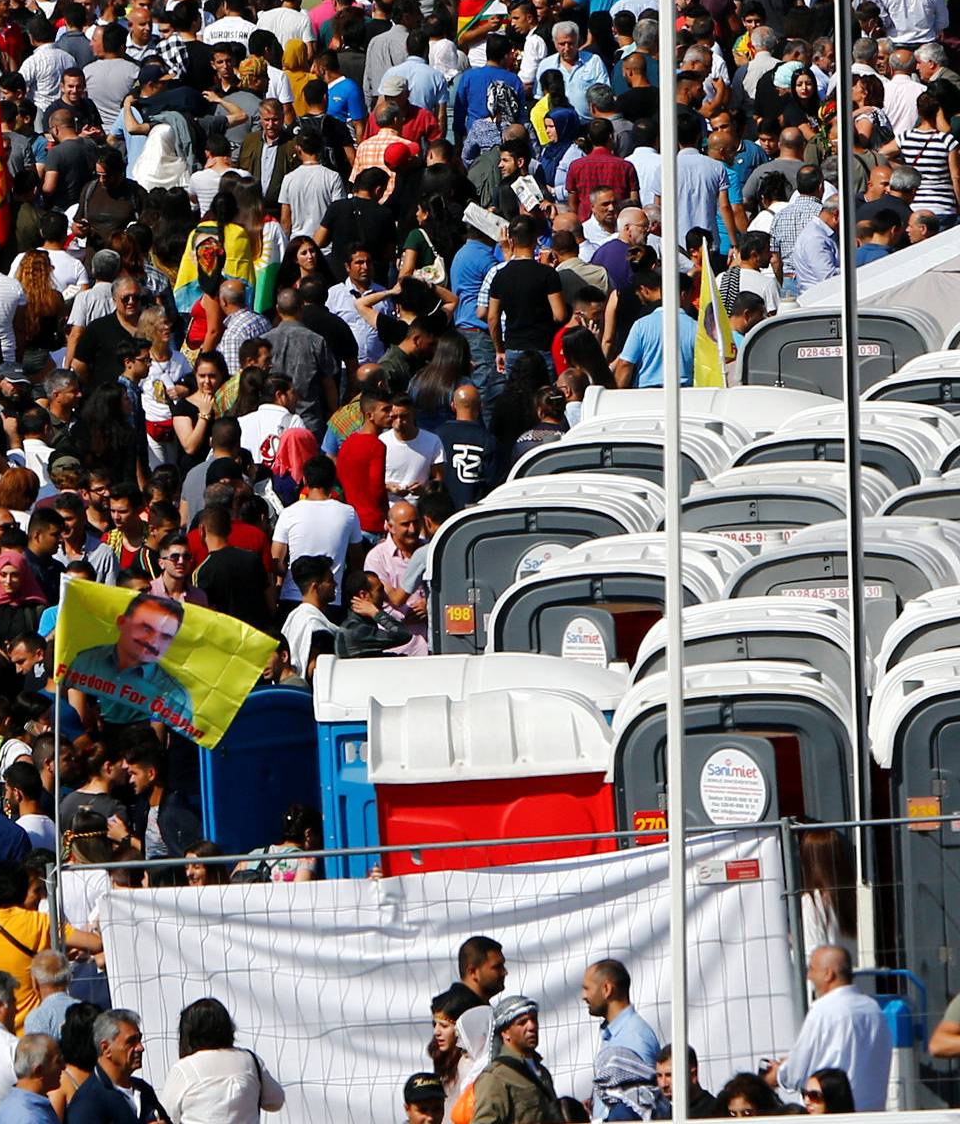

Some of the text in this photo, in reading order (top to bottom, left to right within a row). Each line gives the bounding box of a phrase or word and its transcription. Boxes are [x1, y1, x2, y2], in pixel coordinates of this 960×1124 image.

[799, 346, 879, 358] 02845-9030
[448, 607, 471, 621] 198
[56, 663, 205, 739] Freedom For Öcalan
[707, 764, 759, 779] Sanimiet
[635, 817, 667, 831] 270
